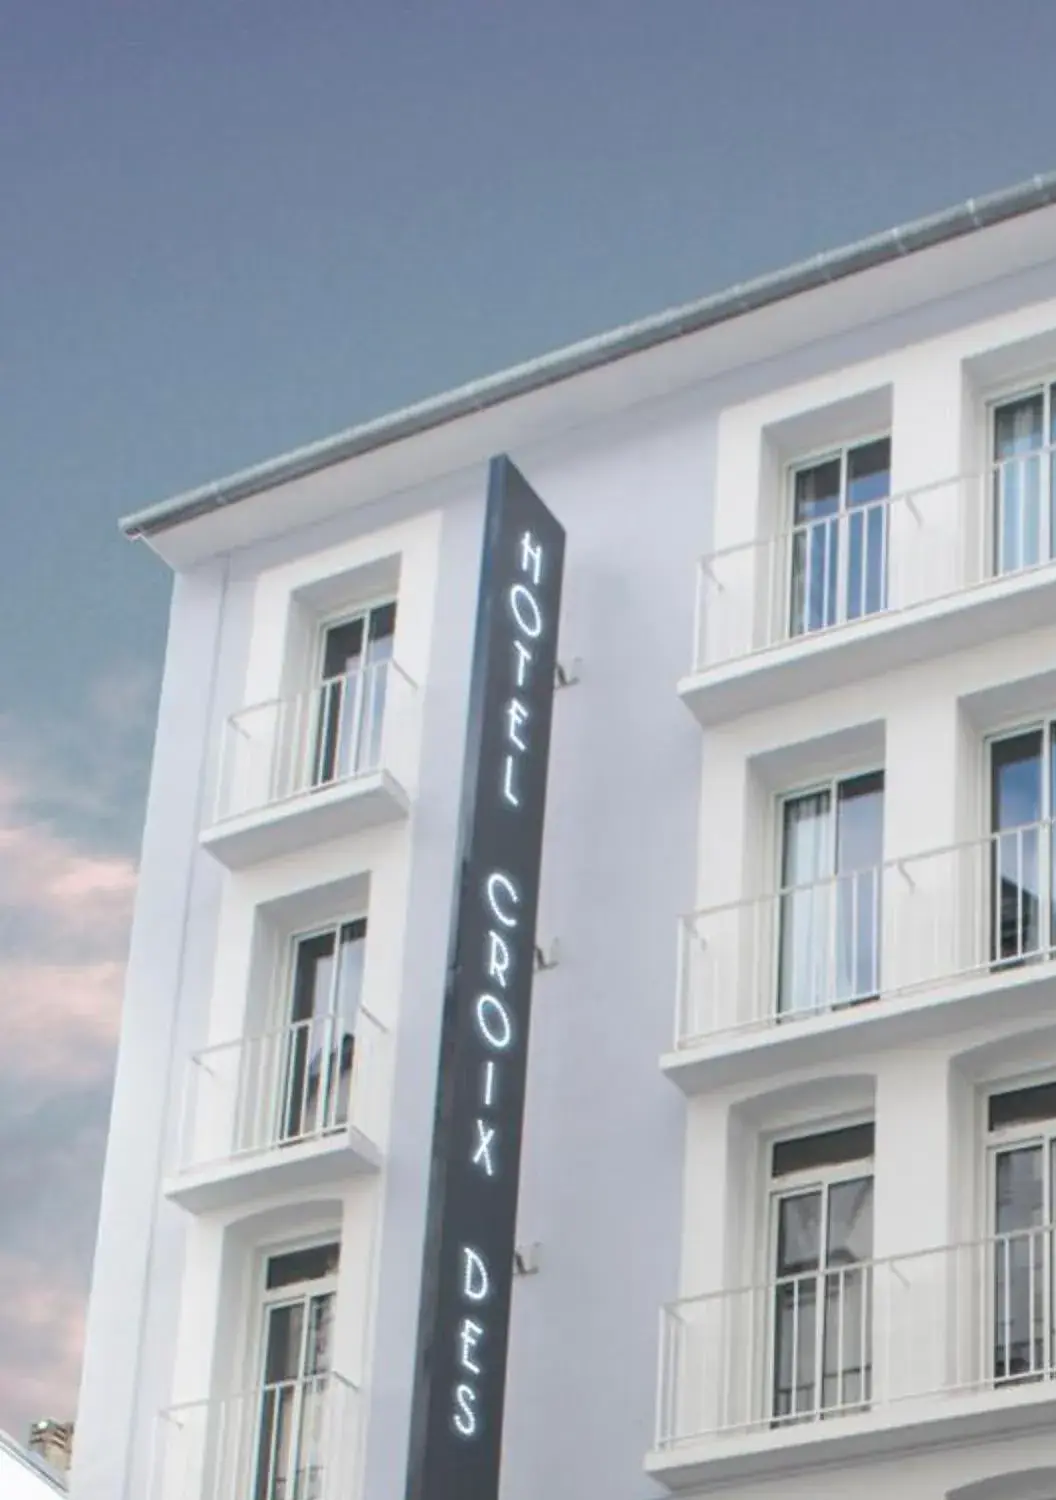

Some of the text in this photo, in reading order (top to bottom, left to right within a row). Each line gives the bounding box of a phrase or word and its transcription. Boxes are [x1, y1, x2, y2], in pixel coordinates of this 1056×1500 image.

[502, 530, 544, 807] HOTEL
[470, 871, 520, 1177] CROIX
[453, 1246, 490, 1438] DES
